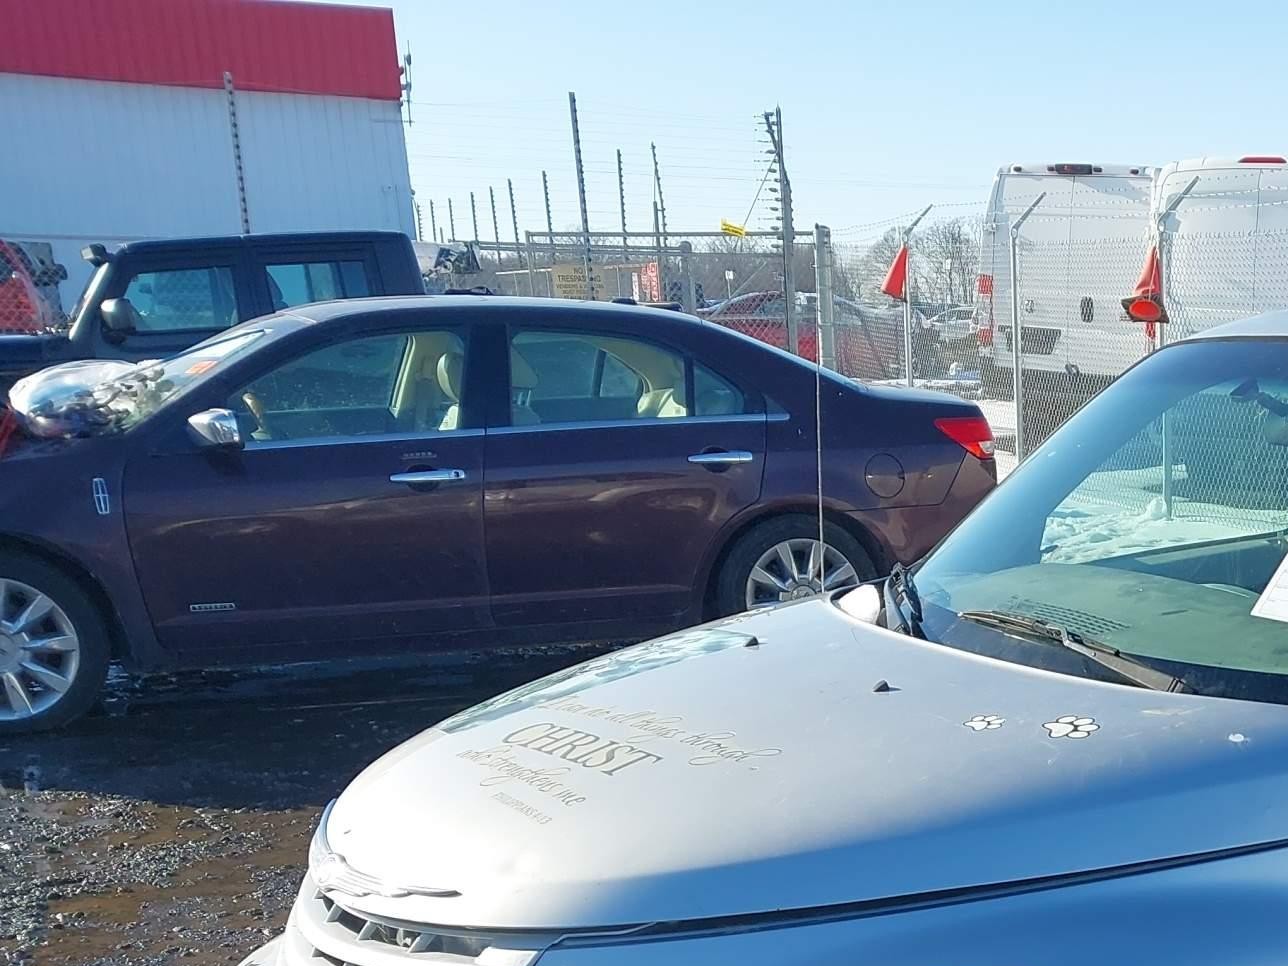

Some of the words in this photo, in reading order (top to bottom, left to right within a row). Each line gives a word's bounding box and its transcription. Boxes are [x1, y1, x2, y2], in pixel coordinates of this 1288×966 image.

[557, 274, 602, 282] TRESPASNG
[501, 722, 664, 777] CHRIST
[679, 731, 783, 767] through
[479, 756, 571, 793] strengthens
[551, 788, 587, 807] me
